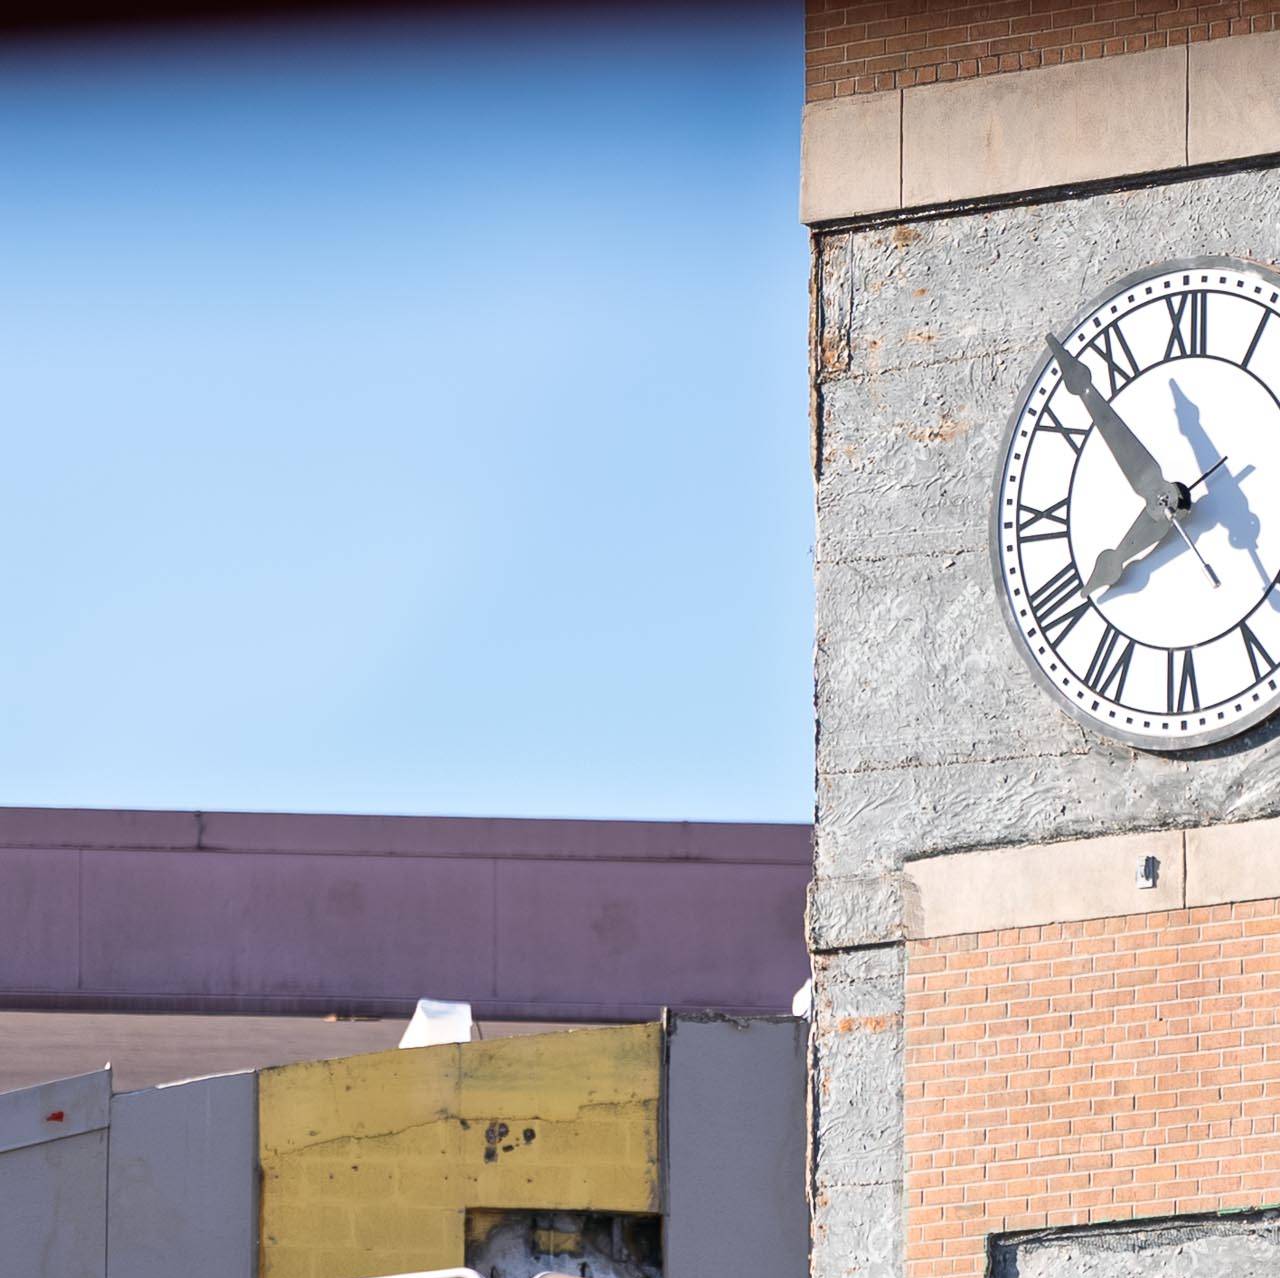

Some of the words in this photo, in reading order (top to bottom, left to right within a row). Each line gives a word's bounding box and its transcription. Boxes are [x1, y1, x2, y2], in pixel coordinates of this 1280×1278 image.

[1087, 321, 1141, 398] XI
[1163, 290, 1208, 361] XII
[1036, 403, 1089, 454] X
[1017, 498, 1069, 543] IX
[1028, 562, 1092, 649] VIII
[1083, 624, 1134, 704] VII
[1167, 649, 1200, 714] VI
[1241, 622, 1276, 682] V
